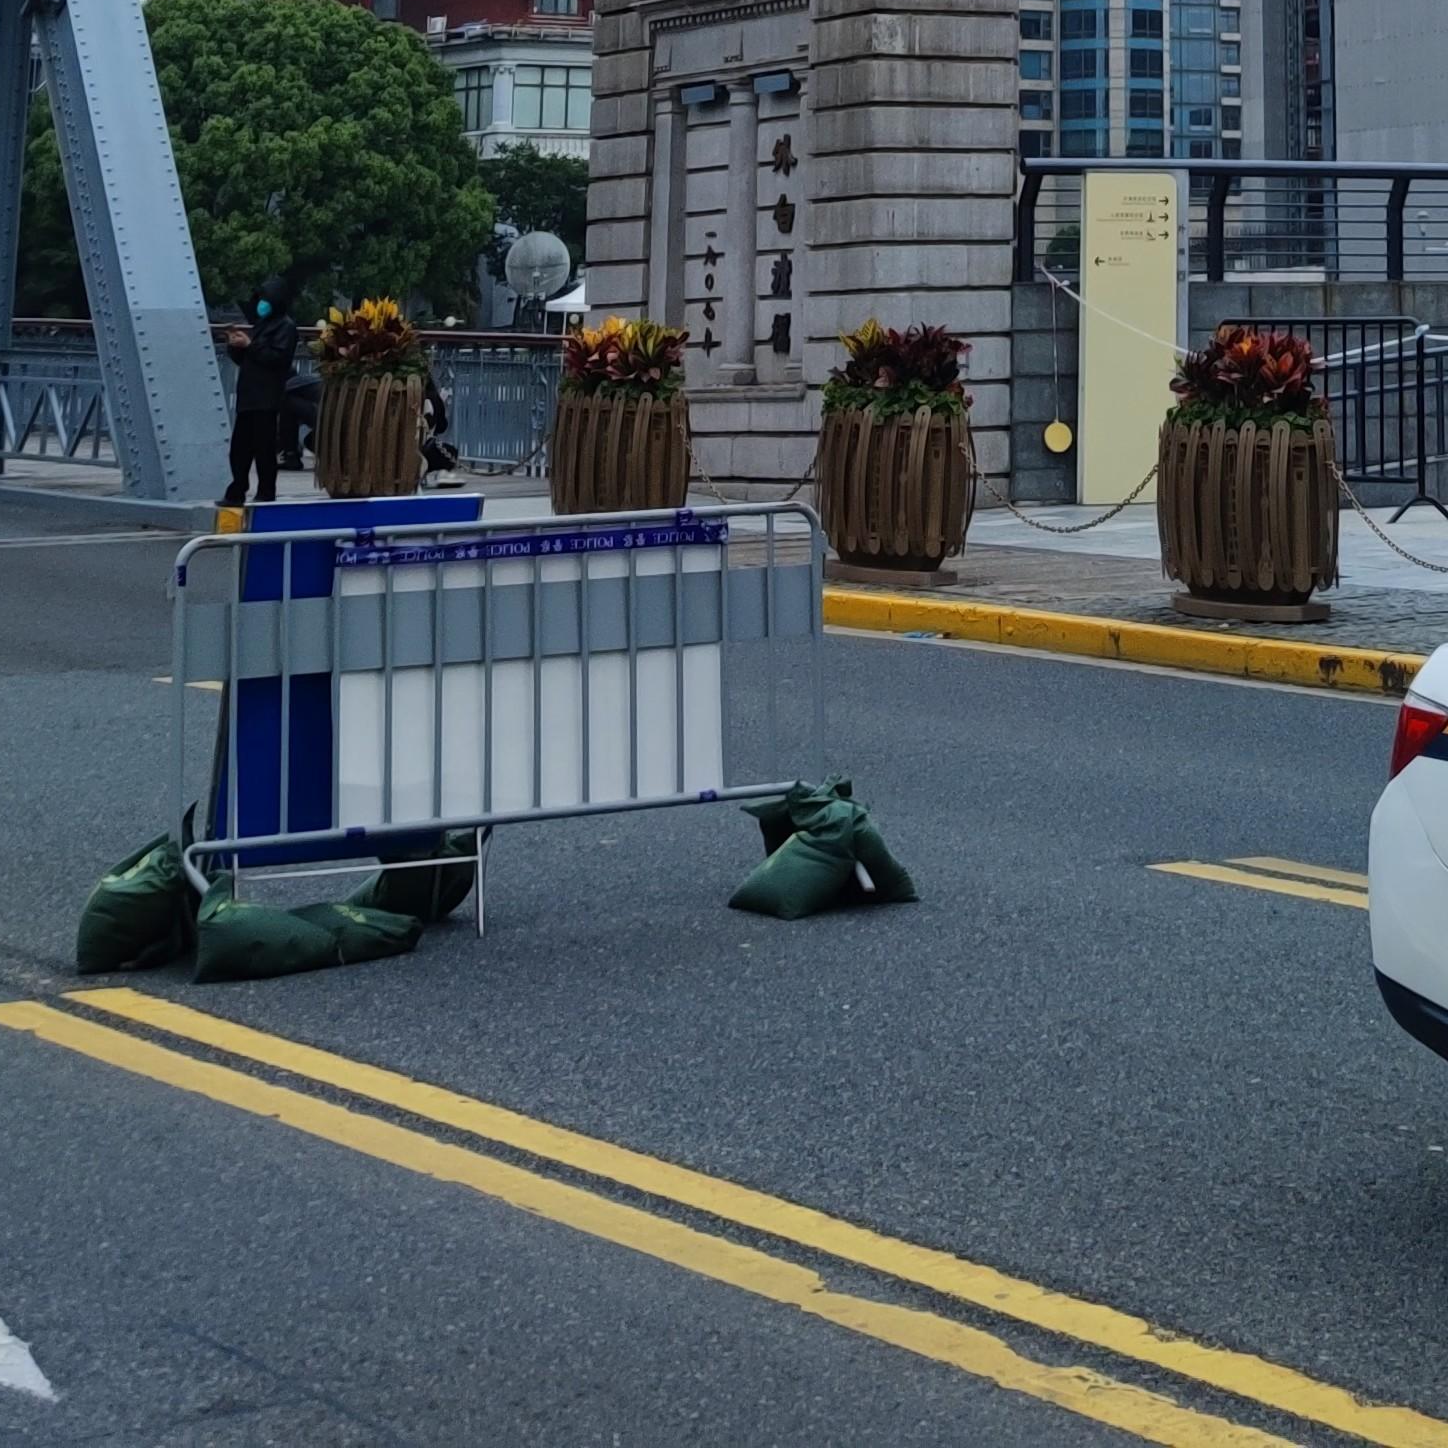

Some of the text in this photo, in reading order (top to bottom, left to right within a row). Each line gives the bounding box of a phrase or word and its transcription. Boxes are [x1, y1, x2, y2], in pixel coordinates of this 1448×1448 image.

[570, 535, 614, 550] POLICE
[653, 530, 695, 544] POLICE
[486, 541, 531, 556] POLICE
